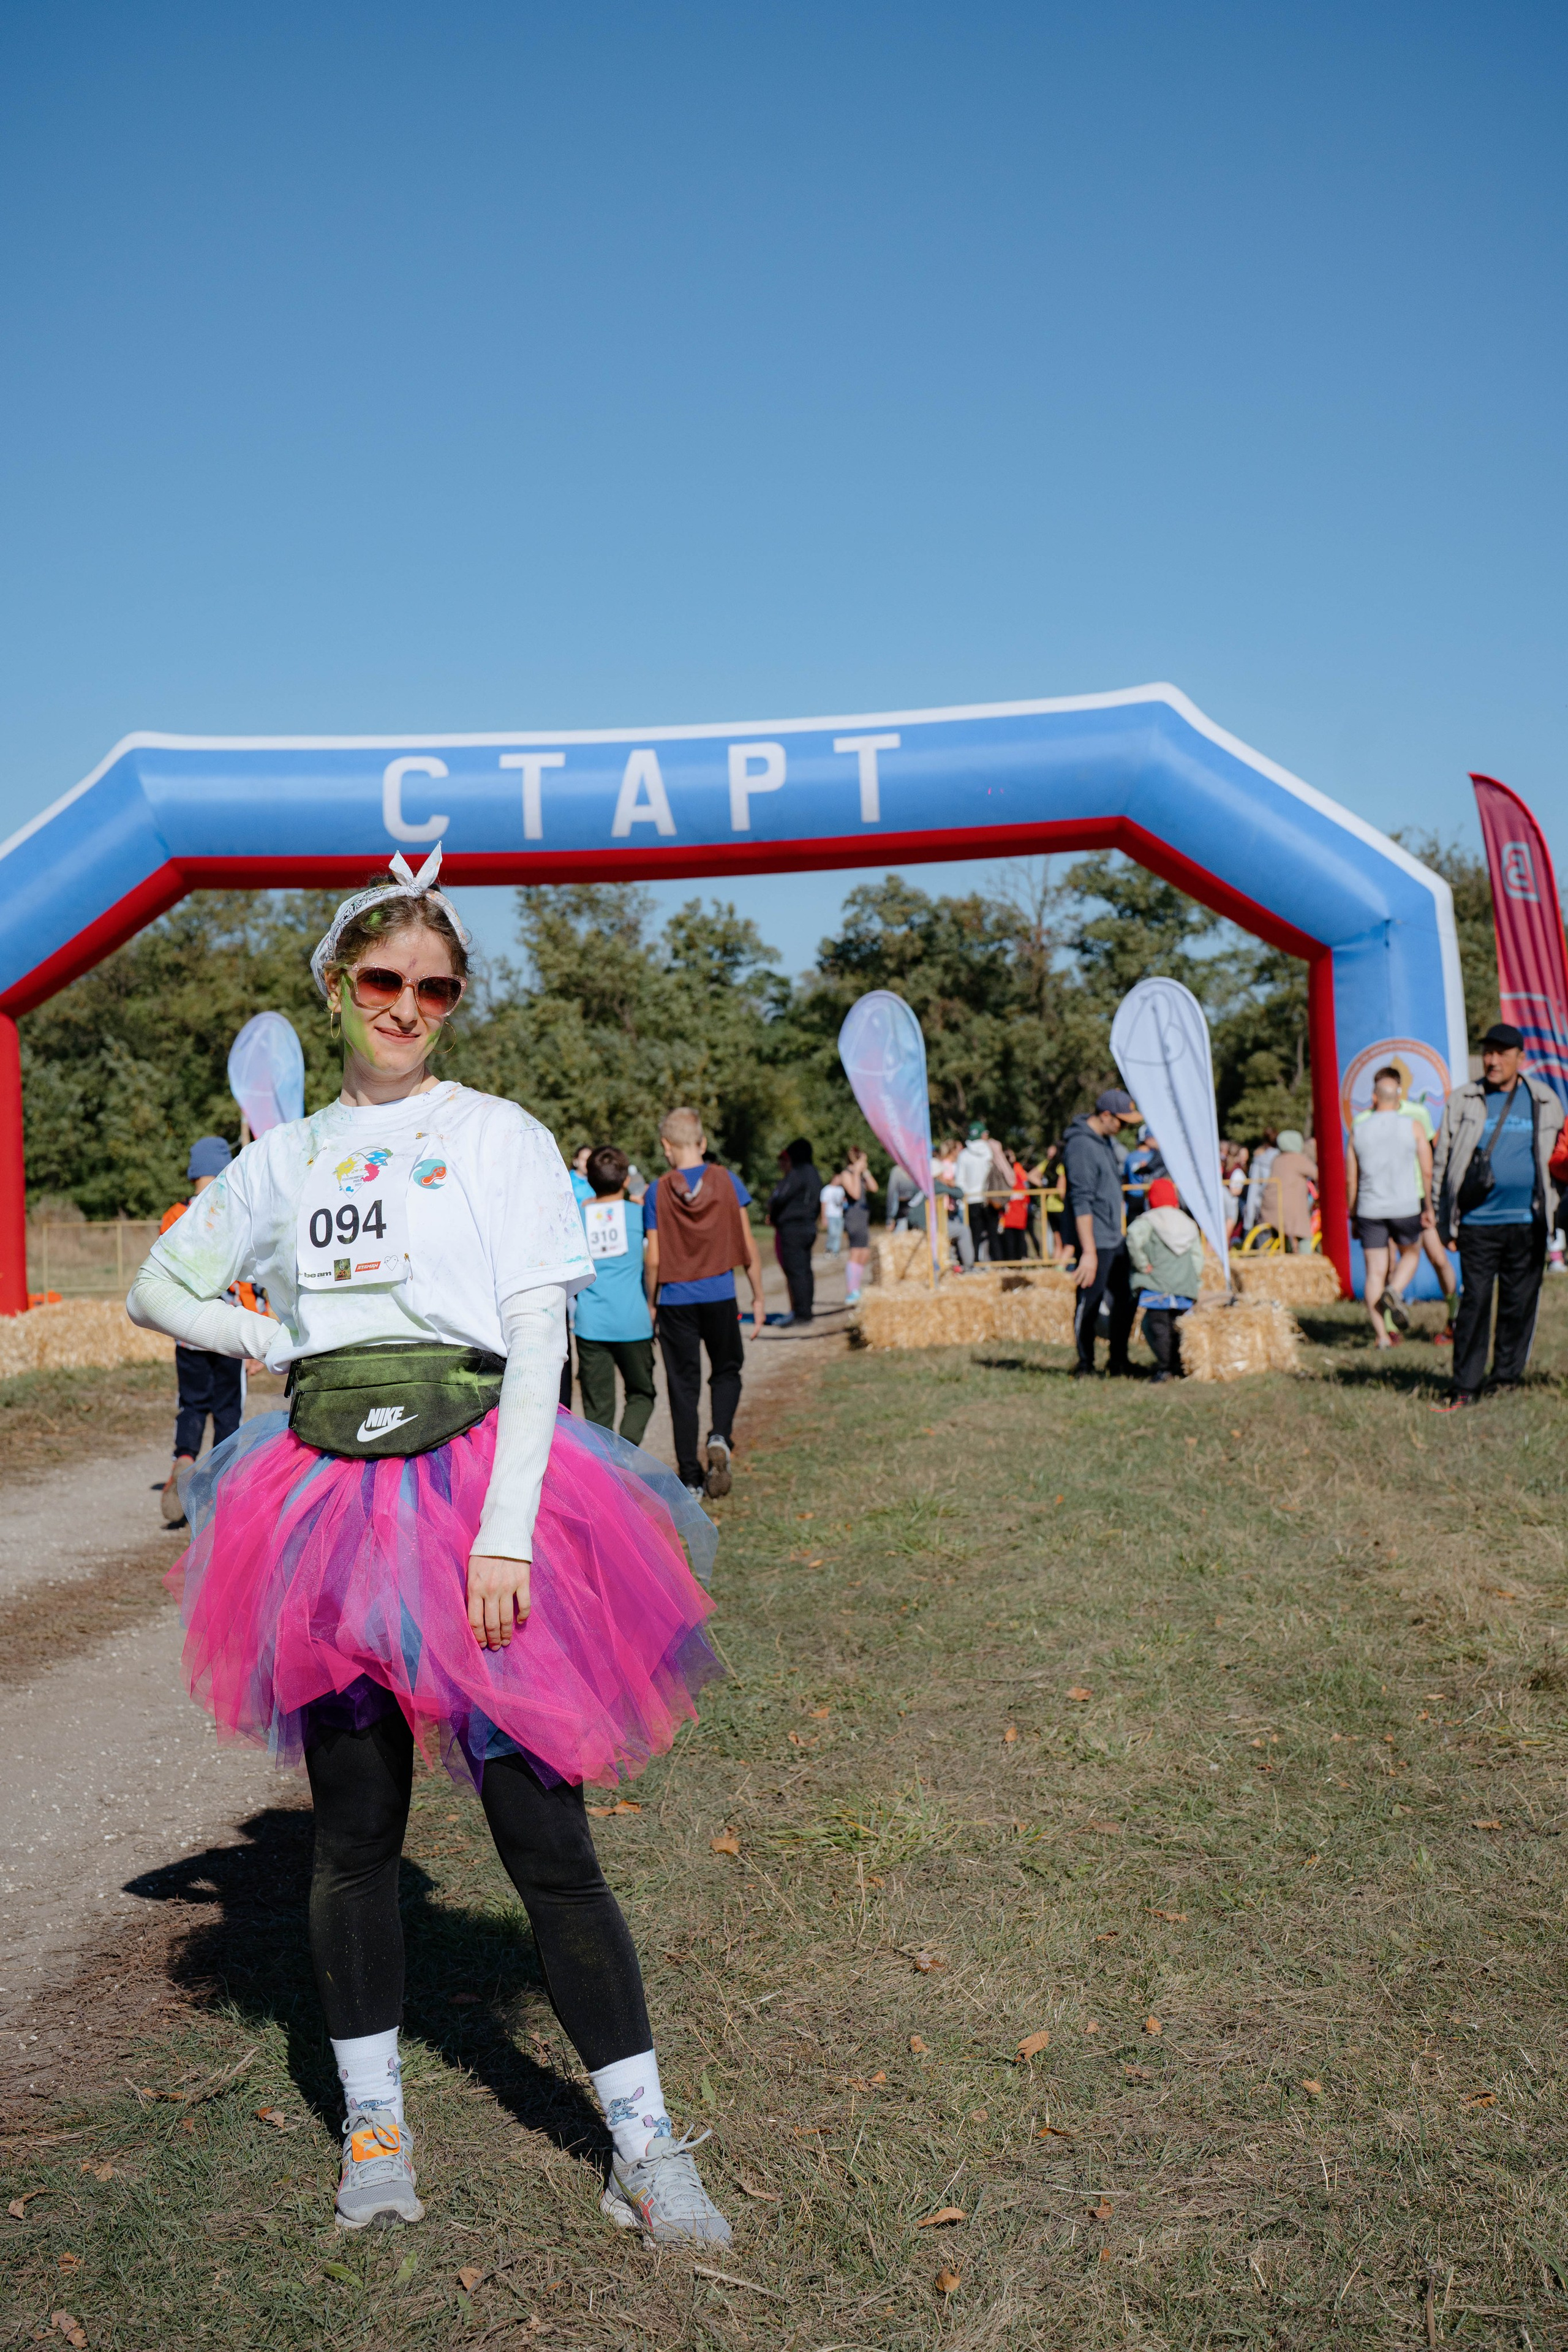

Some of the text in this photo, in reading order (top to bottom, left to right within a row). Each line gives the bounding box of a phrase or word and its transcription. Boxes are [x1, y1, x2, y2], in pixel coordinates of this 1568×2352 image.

[382, 733, 901, 843] СТАРТ
[309, 1199, 386, 1248] 094
[590, 1227, 617, 1245] 310
[365, 1406, 404, 1428] NIKE
